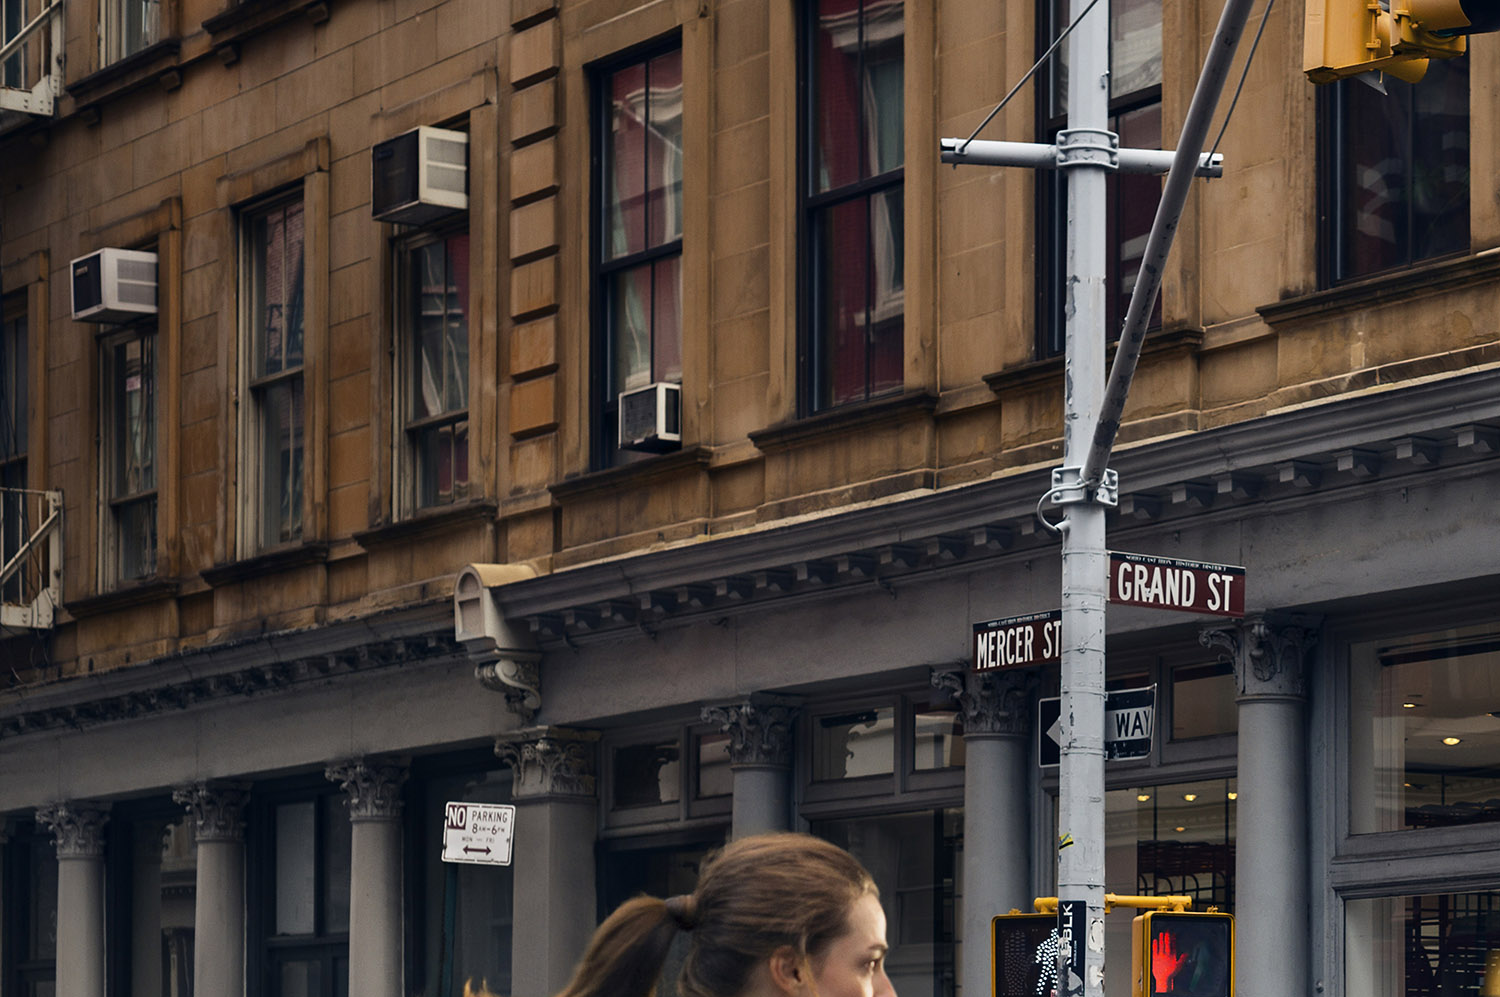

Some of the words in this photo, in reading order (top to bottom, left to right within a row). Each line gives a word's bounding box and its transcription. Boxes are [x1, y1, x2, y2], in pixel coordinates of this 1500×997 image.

[1118, 562, 1195, 607] GRAND
[1207, 572, 1234, 611] ST
[977, 625, 1034, 670] MERCER
[1043, 620, 1062, 659] ST
[1116, 710, 1151, 738] WAY
[447, 805, 466, 828] NO
[472, 811, 508, 823] PARKING
